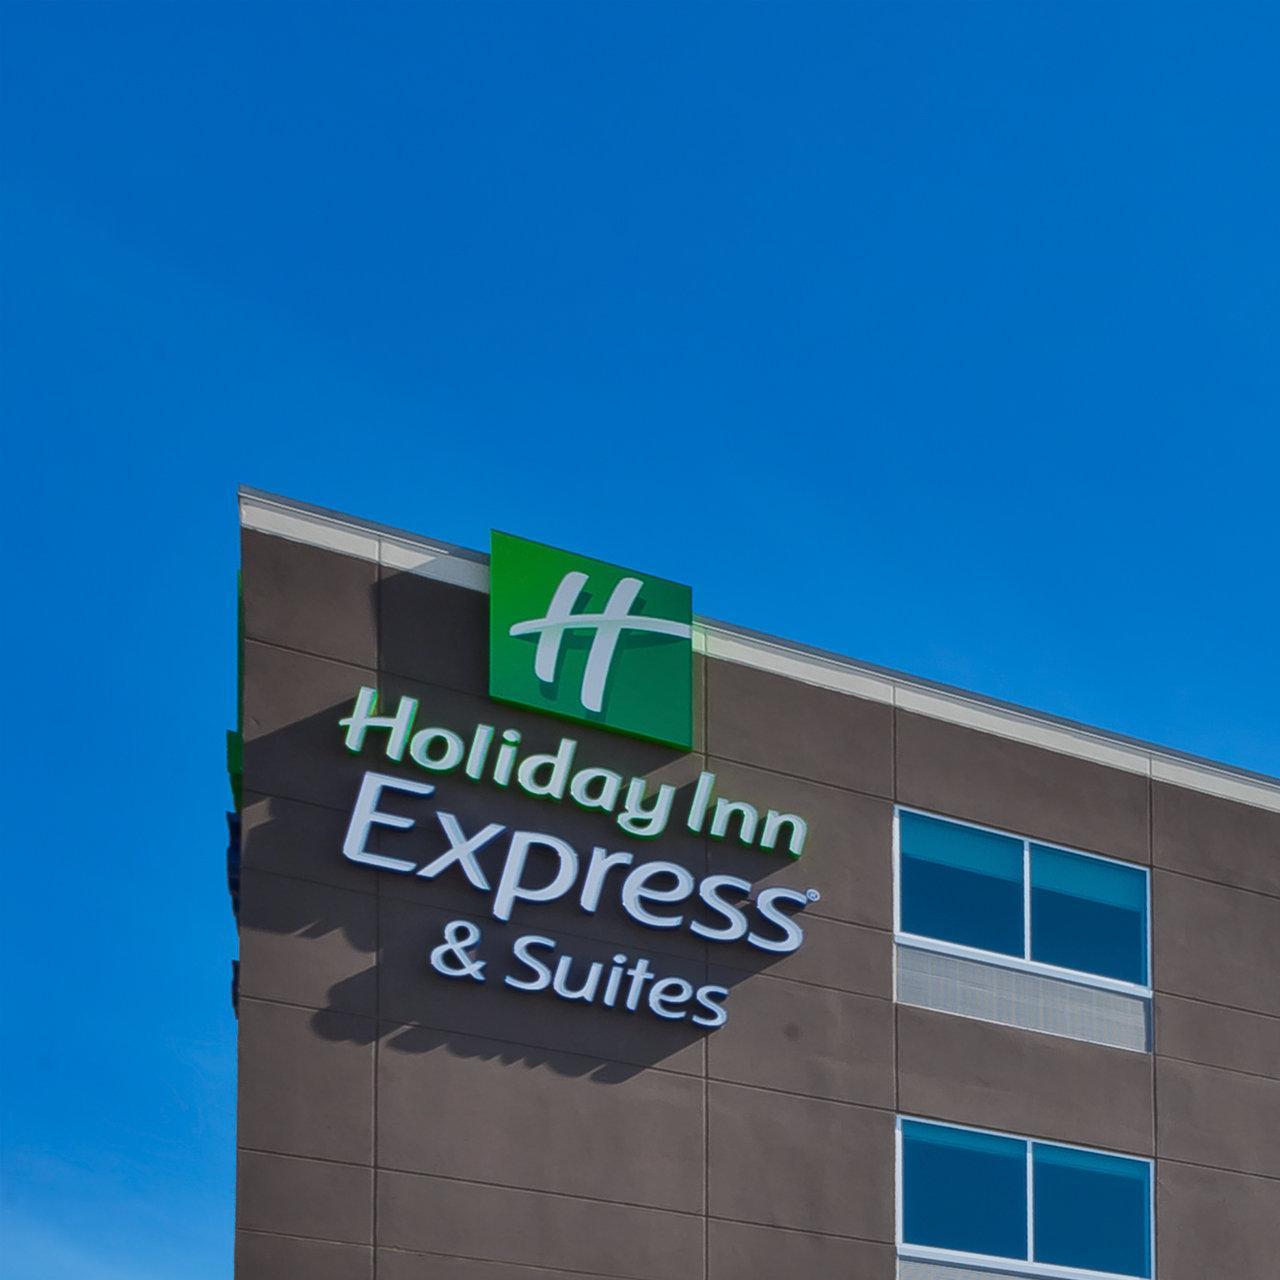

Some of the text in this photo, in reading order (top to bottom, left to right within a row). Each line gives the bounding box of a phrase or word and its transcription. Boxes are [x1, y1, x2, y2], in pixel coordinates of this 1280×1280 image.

[338, 686, 808, 857] Holiday Inn
[341, 770, 807, 955] Express
[429, 920, 729, 1030] & Suites
